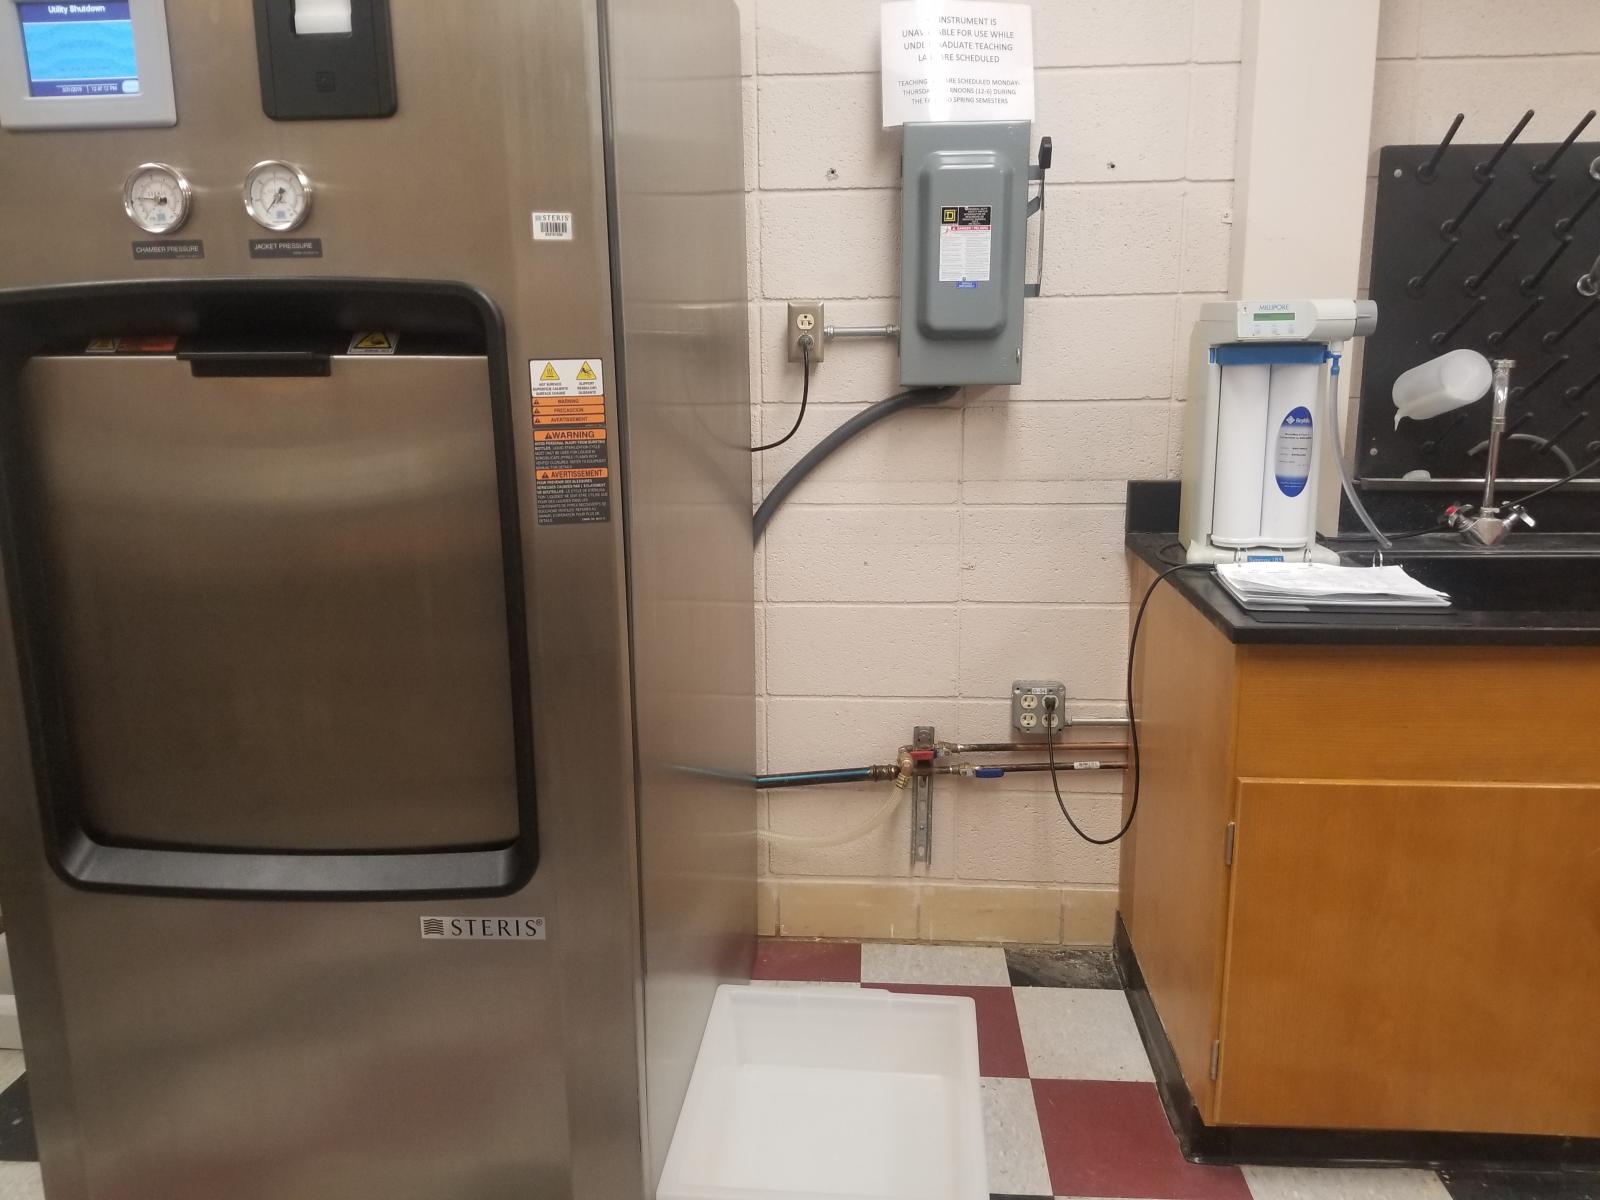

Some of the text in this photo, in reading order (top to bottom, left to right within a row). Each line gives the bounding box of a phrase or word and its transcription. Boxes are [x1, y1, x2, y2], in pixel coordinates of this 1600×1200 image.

[48, 4, 106, 15] Utility Shutdown
[938, 16, 997, 26] INSTRUMENT IS
[957, 29, 971, 37] FOR
[974, 30, 988, 38] USE
[991, 31, 1015, 39] WHILE
[975, 42, 1013, 51] TEACHING
[956, 54, 999, 63] SCHEDULED
[898, 78, 928, 87] TEACHING
[136, 245, 199, 254] CHAMBER PRESSURE
[1258, 303, 1289, 311] MILLIPORE
[552, 430, 595, 440] WARNING
[551, 469, 603, 478] AVERTISSEMENT
